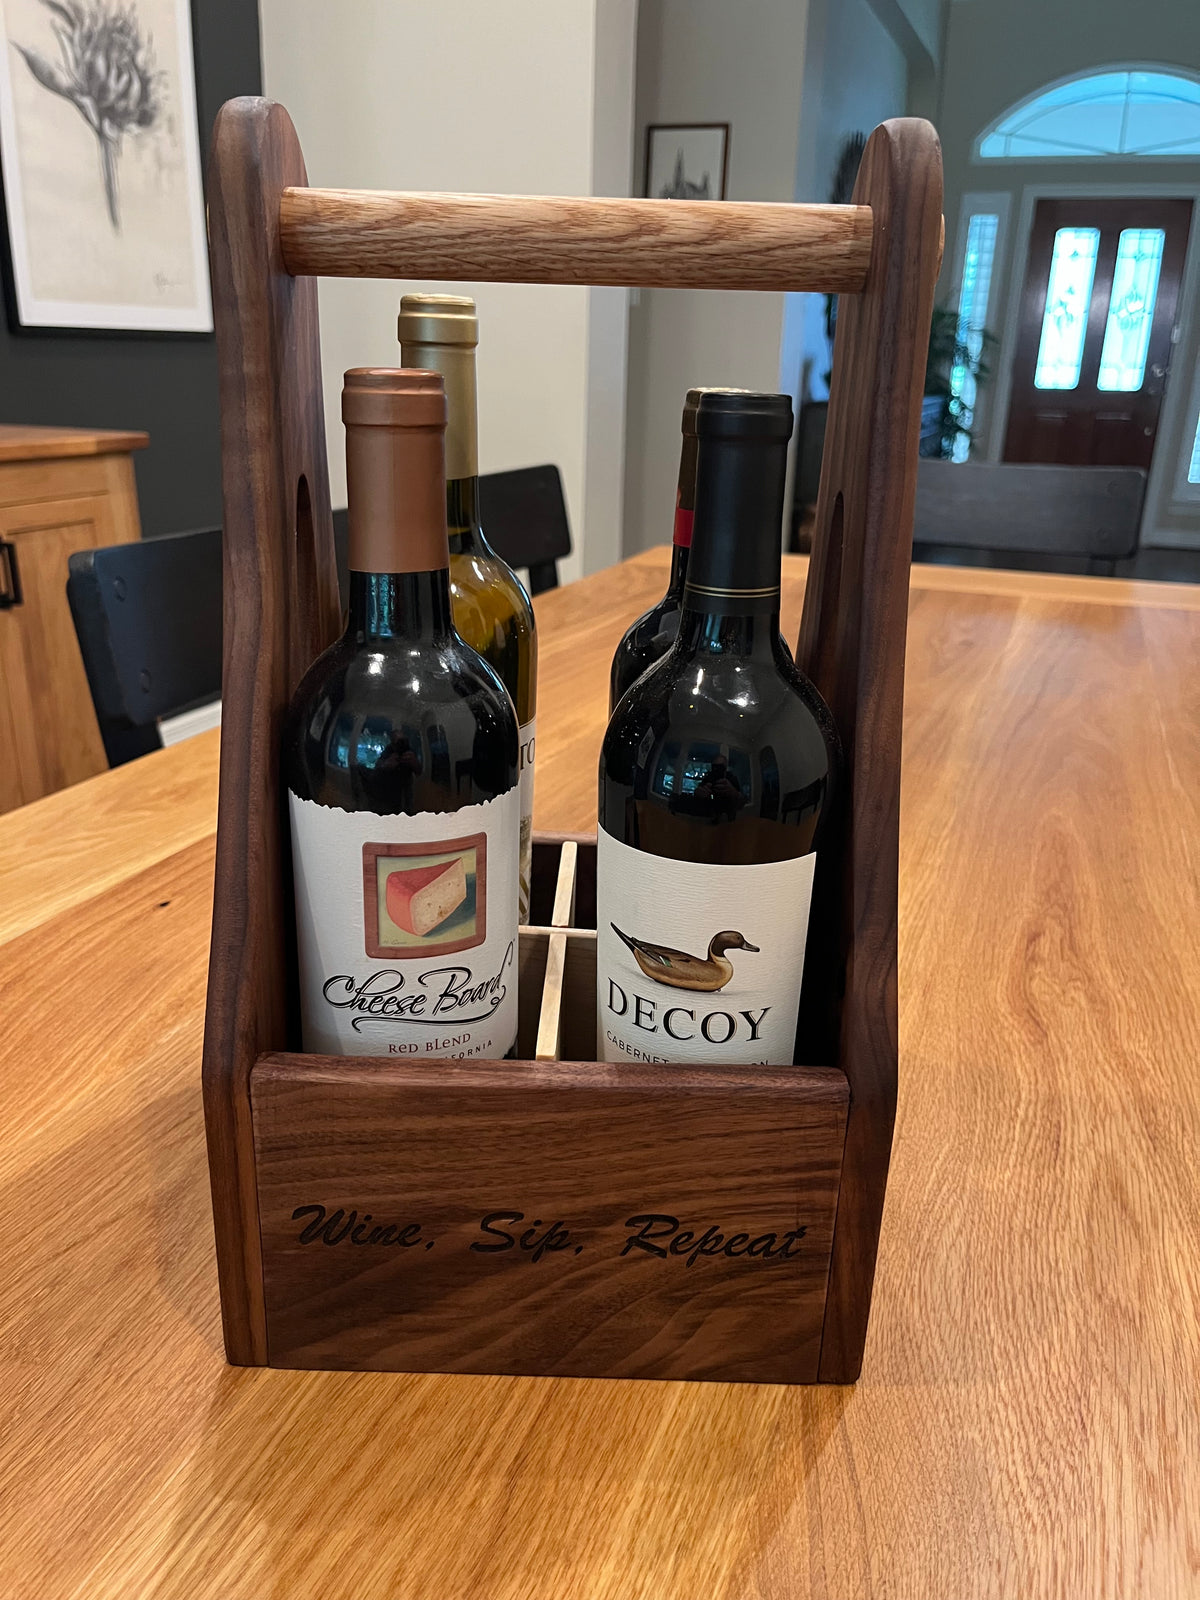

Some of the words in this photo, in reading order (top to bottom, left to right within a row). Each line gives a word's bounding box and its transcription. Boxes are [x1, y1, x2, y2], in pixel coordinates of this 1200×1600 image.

[323, 969, 427, 1016] Cheese
[418, 941, 513, 1016] Board
[607, 976, 772, 1044] DECOY
[606, 1030, 669, 1064] CABERNET
[292, 1204, 435, 1250] Wine,
[469, 1211, 583, 1263] Sip,
[620, 1213, 807, 1268] Repeat
